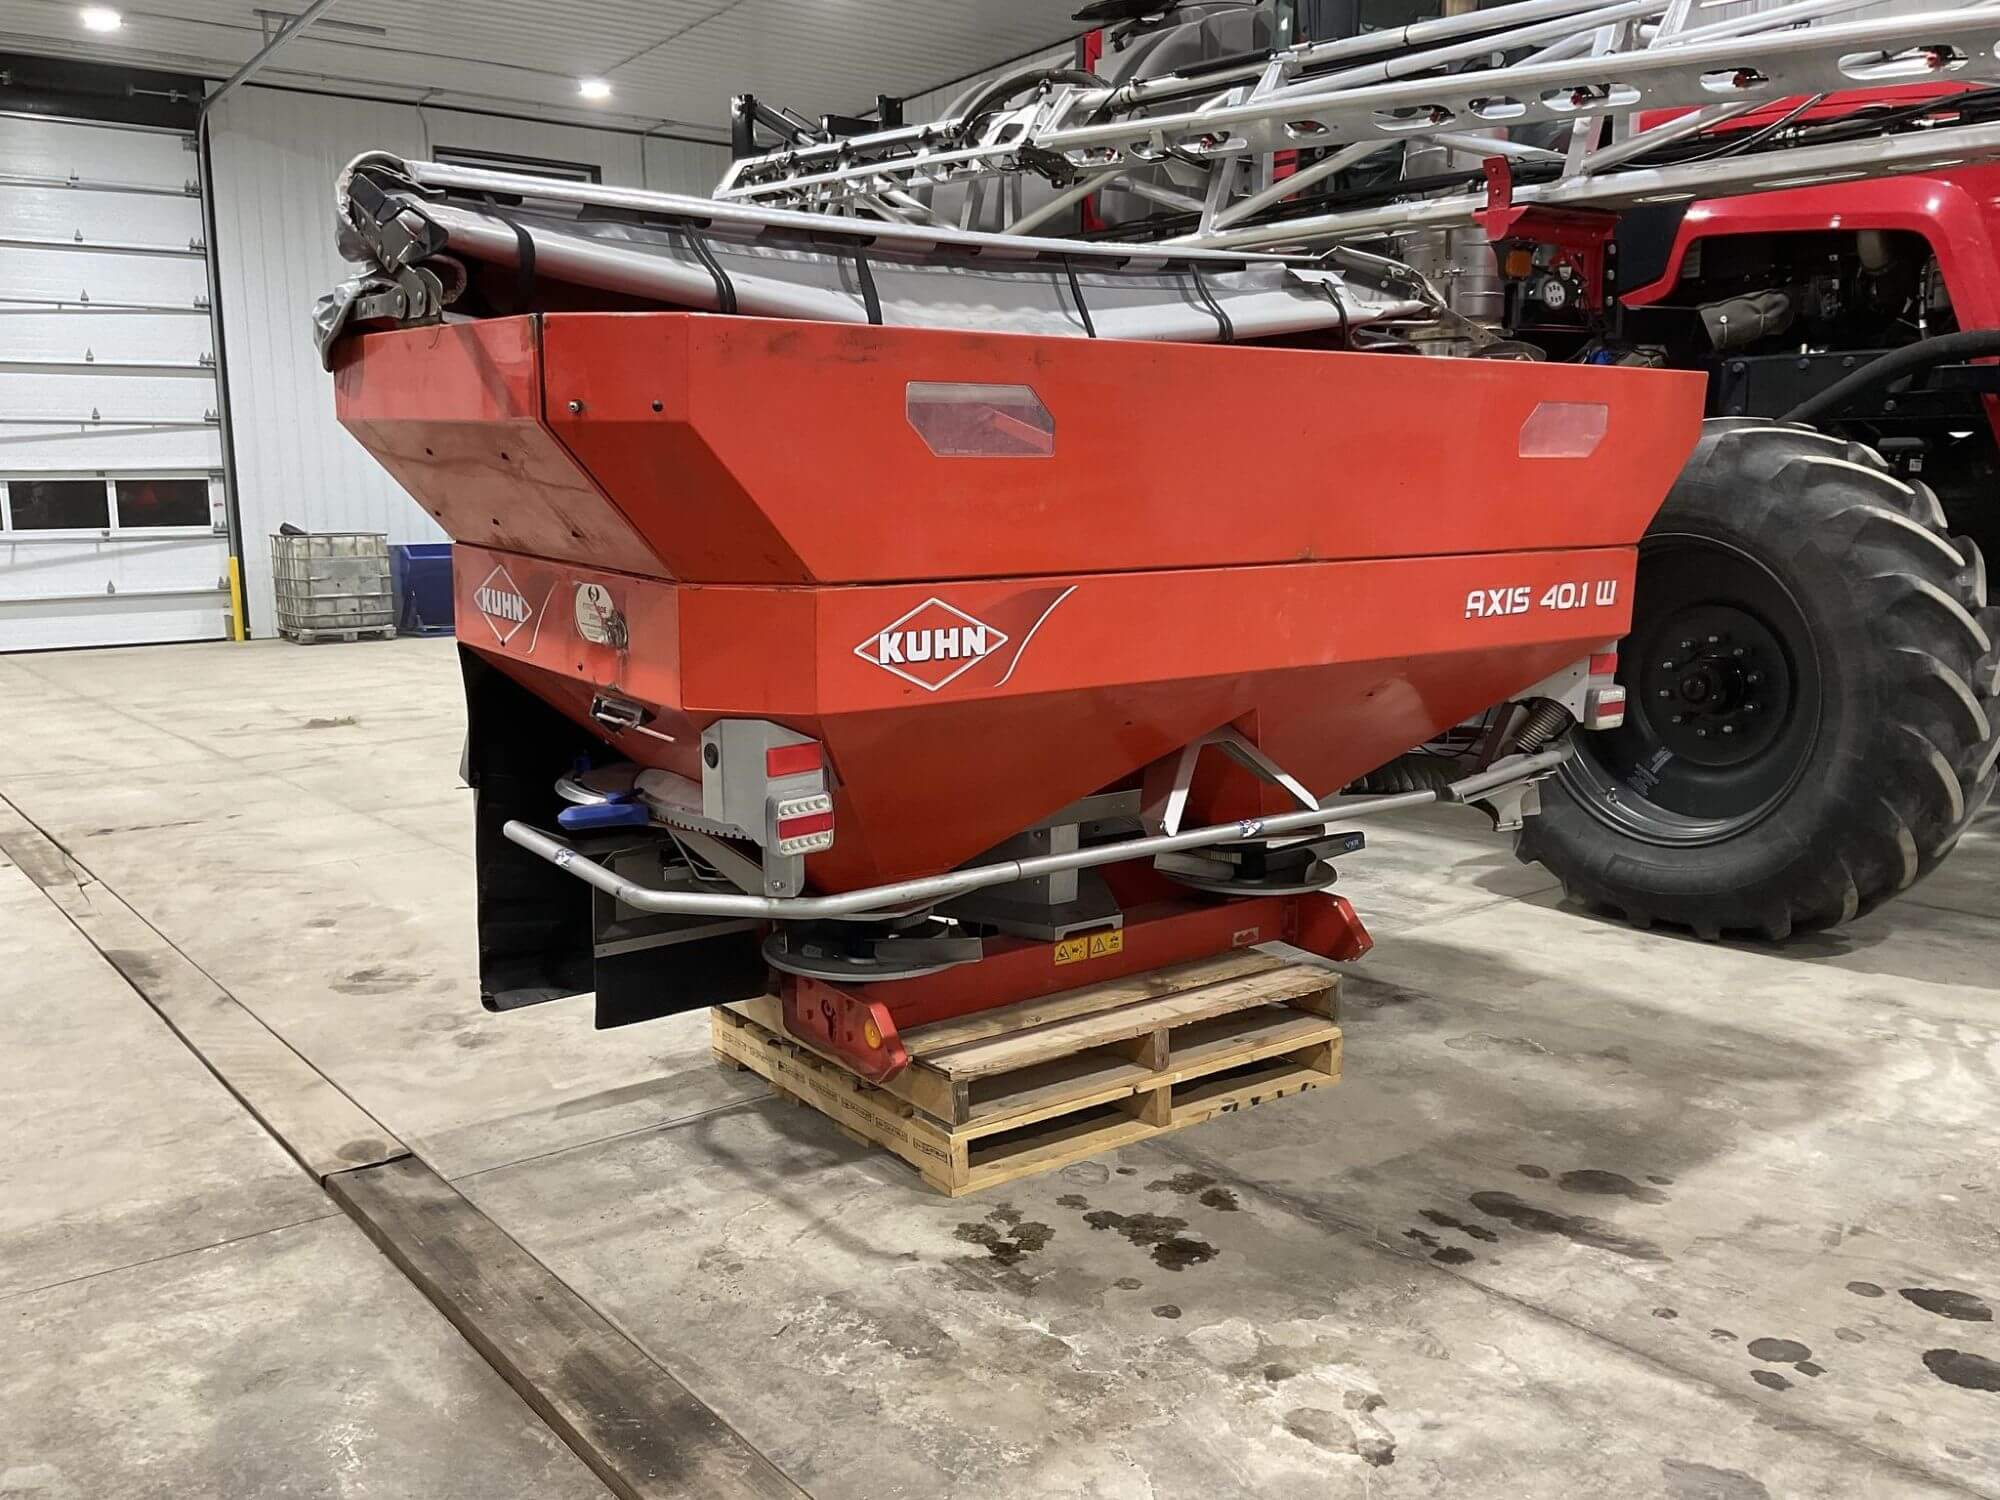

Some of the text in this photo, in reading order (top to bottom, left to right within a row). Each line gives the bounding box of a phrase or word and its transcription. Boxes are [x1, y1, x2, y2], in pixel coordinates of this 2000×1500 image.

[481, 587, 523, 622] KUHN
[1465, 580, 1617, 619] AXIS 40.1 W
[879, 625, 986, 665] KUHN
